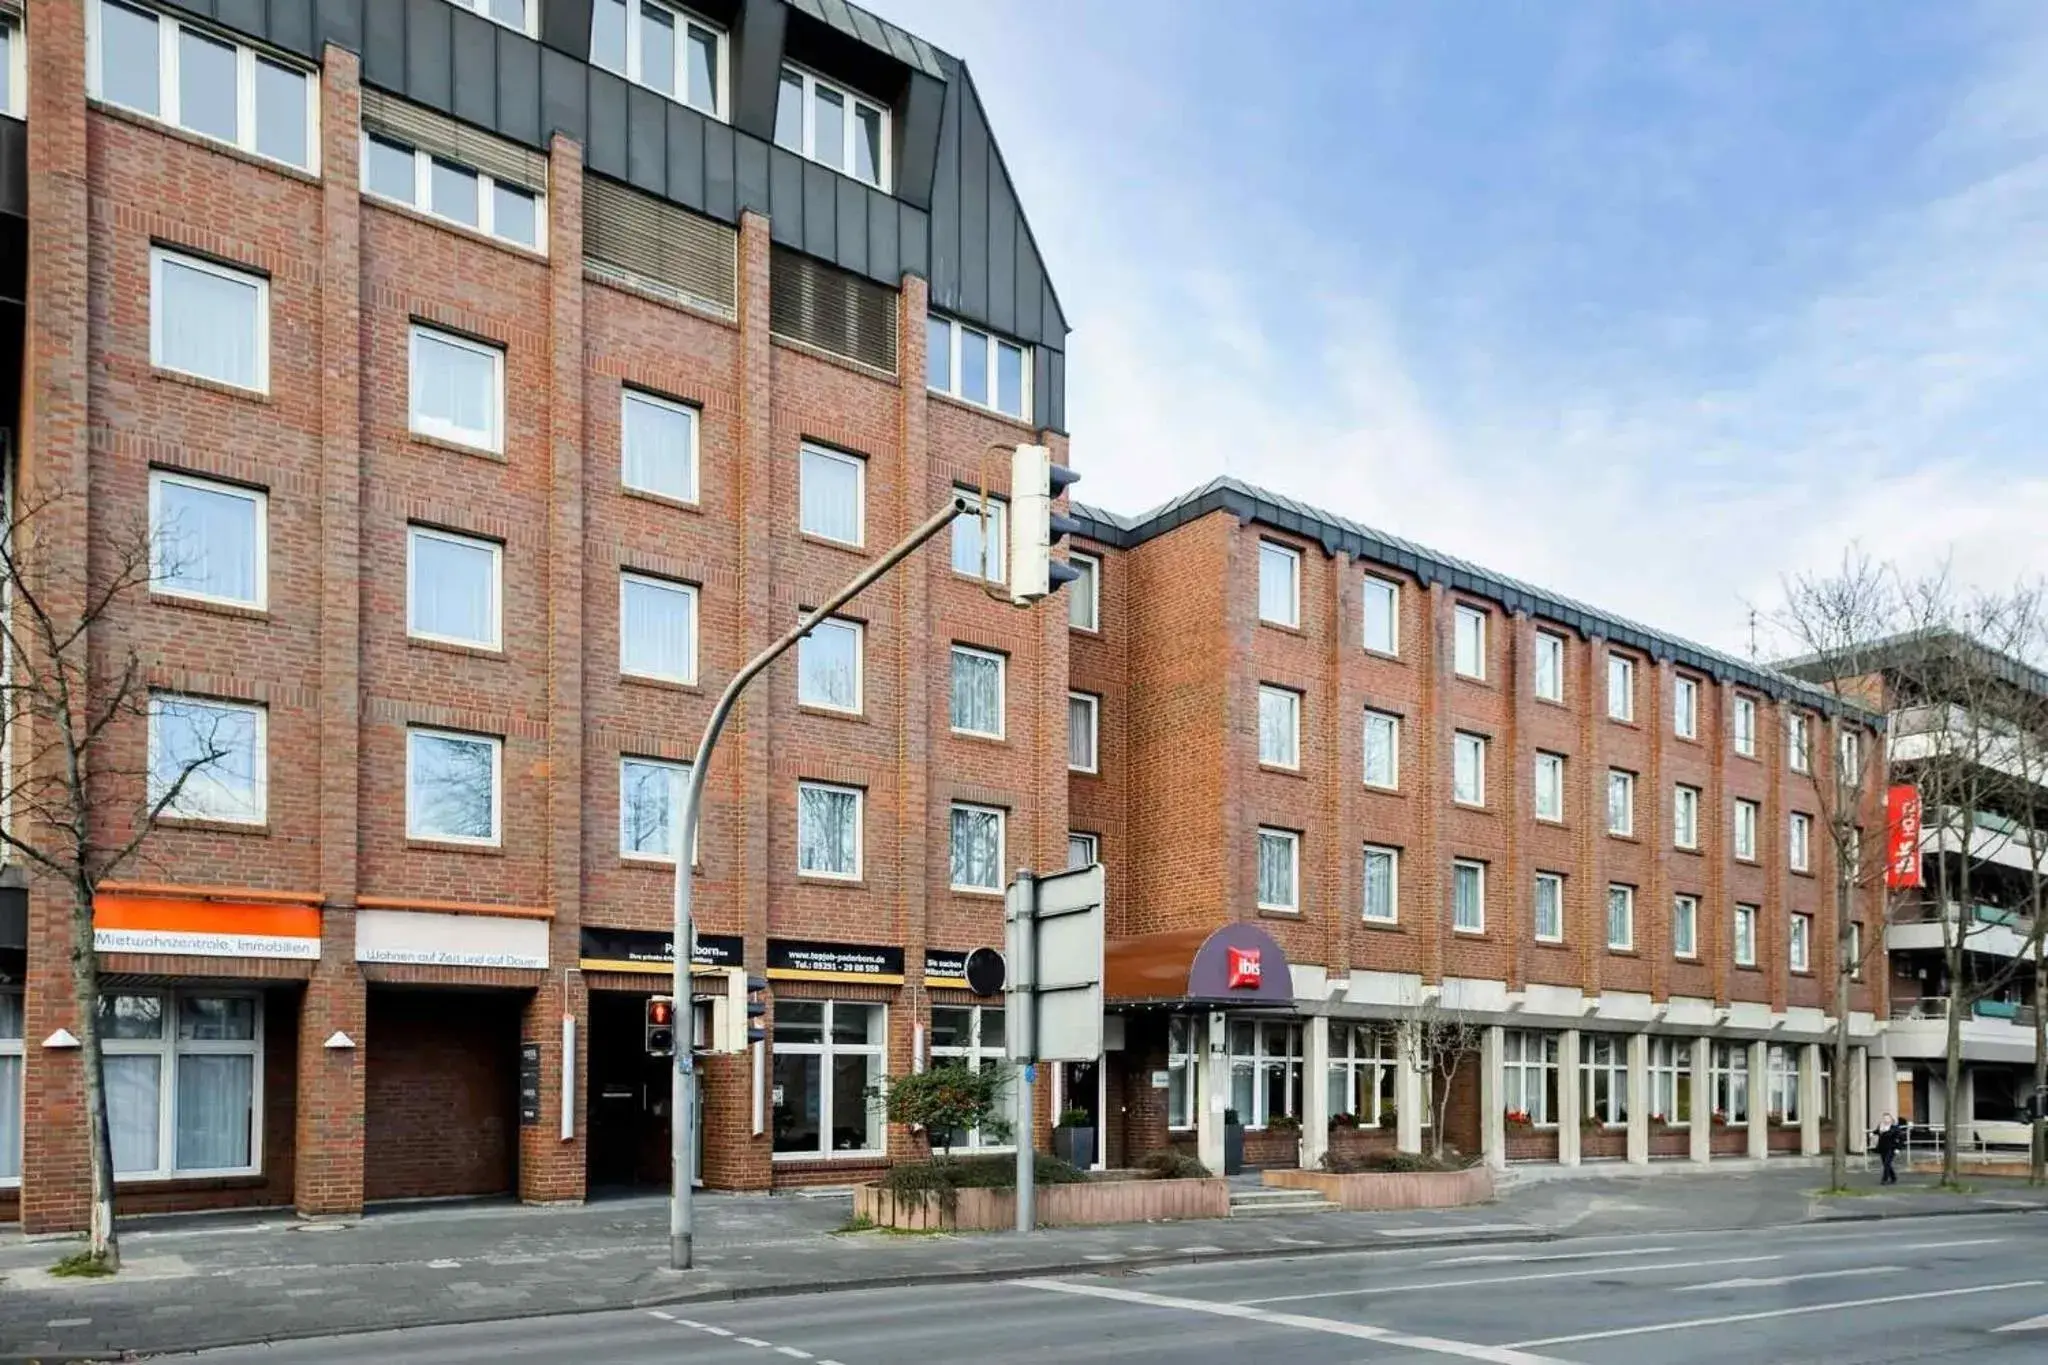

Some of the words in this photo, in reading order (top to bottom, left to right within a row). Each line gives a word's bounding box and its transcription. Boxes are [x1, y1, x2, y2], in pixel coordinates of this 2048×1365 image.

[237, 939, 310, 954] Immobilien
[366, 950, 416, 961] Wohnen
[417, 952, 436, 962] auf
[439, 952, 461, 963] Zeit
[463, 953, 484, 964] und
[486, 954, 504, 964] auf
[506, 954, 538, 966] Dauer
[788, 951, 886, 964] www.topjob-paderborn.de
[1239, 957, 1261, 975] ibis
